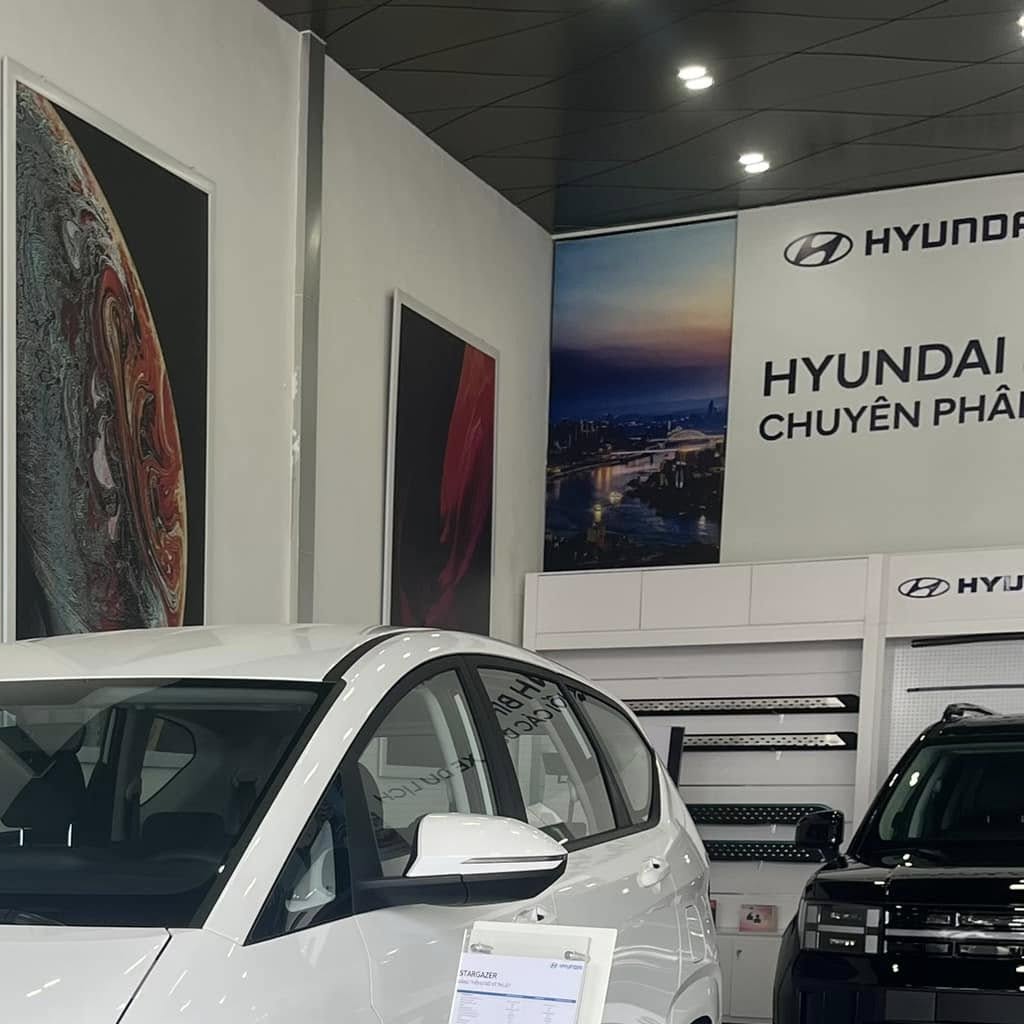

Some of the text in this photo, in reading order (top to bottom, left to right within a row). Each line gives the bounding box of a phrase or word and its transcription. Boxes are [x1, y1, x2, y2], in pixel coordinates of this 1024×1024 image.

[763, 336, 1006, 397] HYUNDAI
[759, 384, 1024, 442] CHUYÊN PHÂ
[459, 969, 498, 979] STARGAZER
